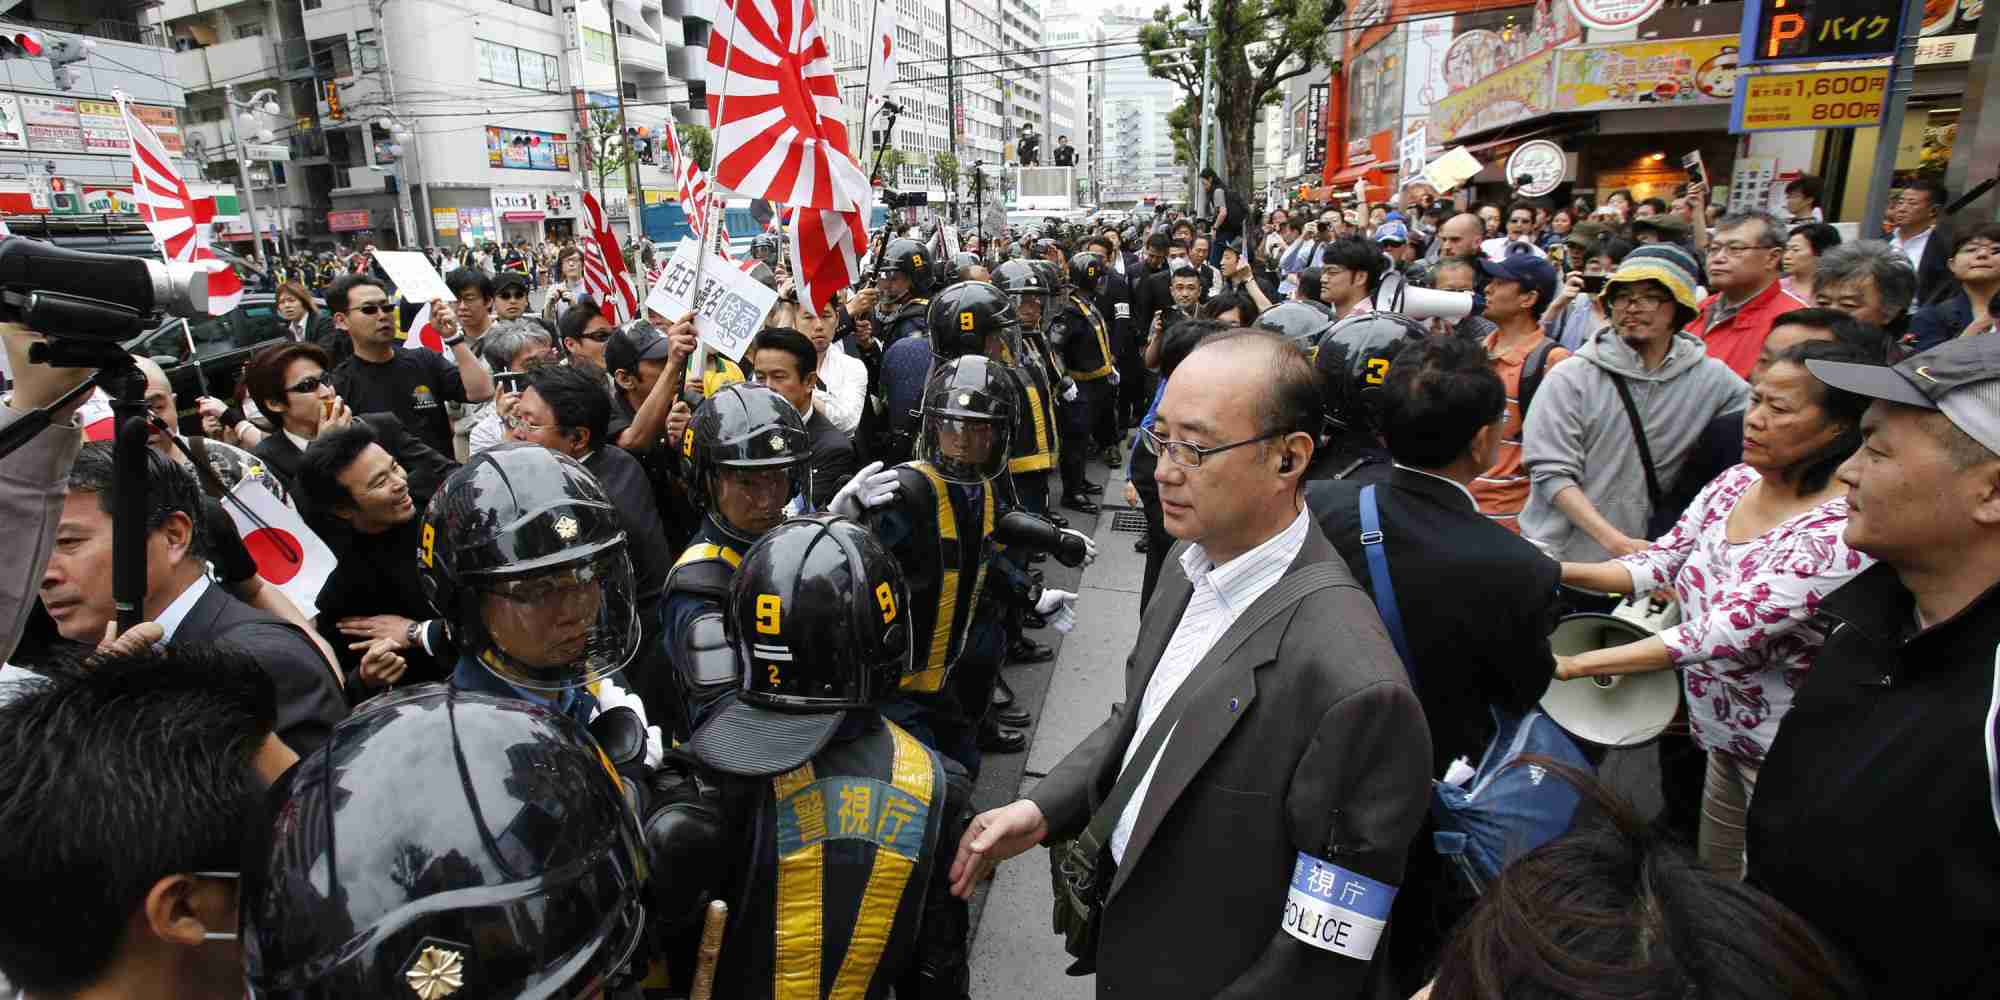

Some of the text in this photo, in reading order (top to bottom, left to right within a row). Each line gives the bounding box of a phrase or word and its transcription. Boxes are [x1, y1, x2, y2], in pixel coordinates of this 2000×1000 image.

[1768, 13, 1806, 57] P
[1818, 15, 1889, 41] バイク
[1796, 76, 1885, 98] 1,600円
[1811, 102, 1880, 120] 800円
[959, 311, 974, 331] 9
[1365, 358, 1389, 384] 3
[682, 427, 695, 457] 9
[423, 522, 434, 568] 9
[755, 593, 782, 635] 9
[876, 582, 896, 624] 9
[793, 783, 918, 845] 警視庁
